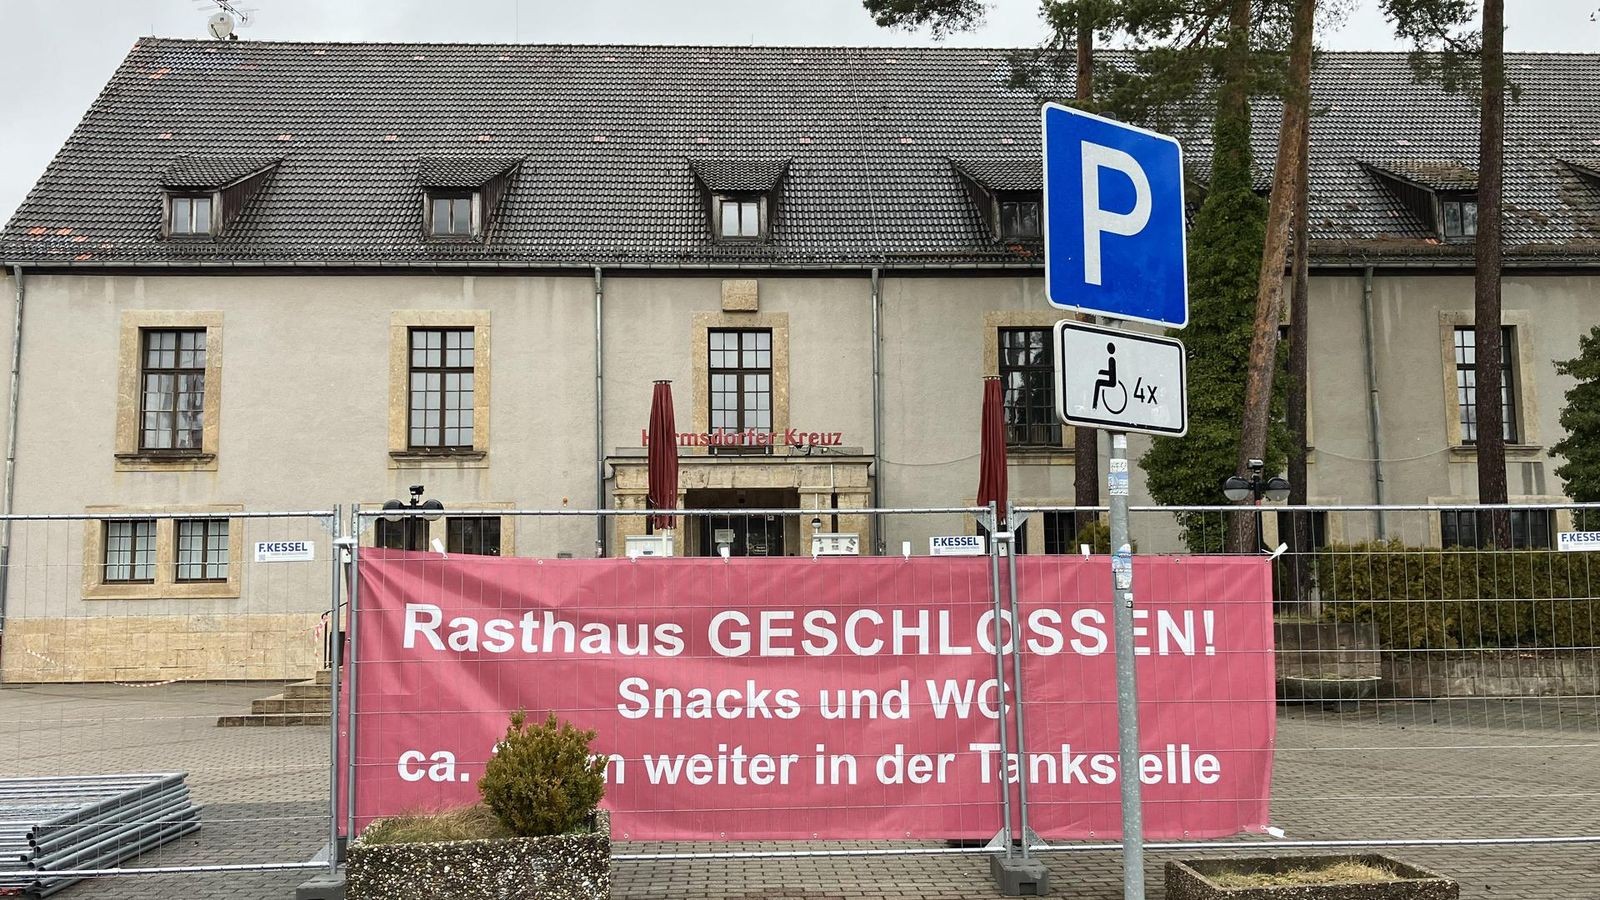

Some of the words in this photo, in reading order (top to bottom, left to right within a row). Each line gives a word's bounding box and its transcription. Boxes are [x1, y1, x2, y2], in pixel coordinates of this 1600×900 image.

[1081, 140, 1152, 286] P
[1133, 376, 1158, 405] 4x
[784, 428, 842, 446] Kreuz
[258, 542, 308, 552] F.KESSEL
[933, 537, 979, 546] F.KESSEL
[403, 603, 685, 657] Rasthaus
[617, 677, 801, 719] Snacks
[820, 680, 910, 719] und
[926, 678, 1010, 719] WC
[397, 750, 471, 782] ca.
[643, 744, 799, 785] weiter
[815, 744, 857, 785] in
[876, 744, 956, 784] der
[969, 743, 1221, 784] Tankselle
